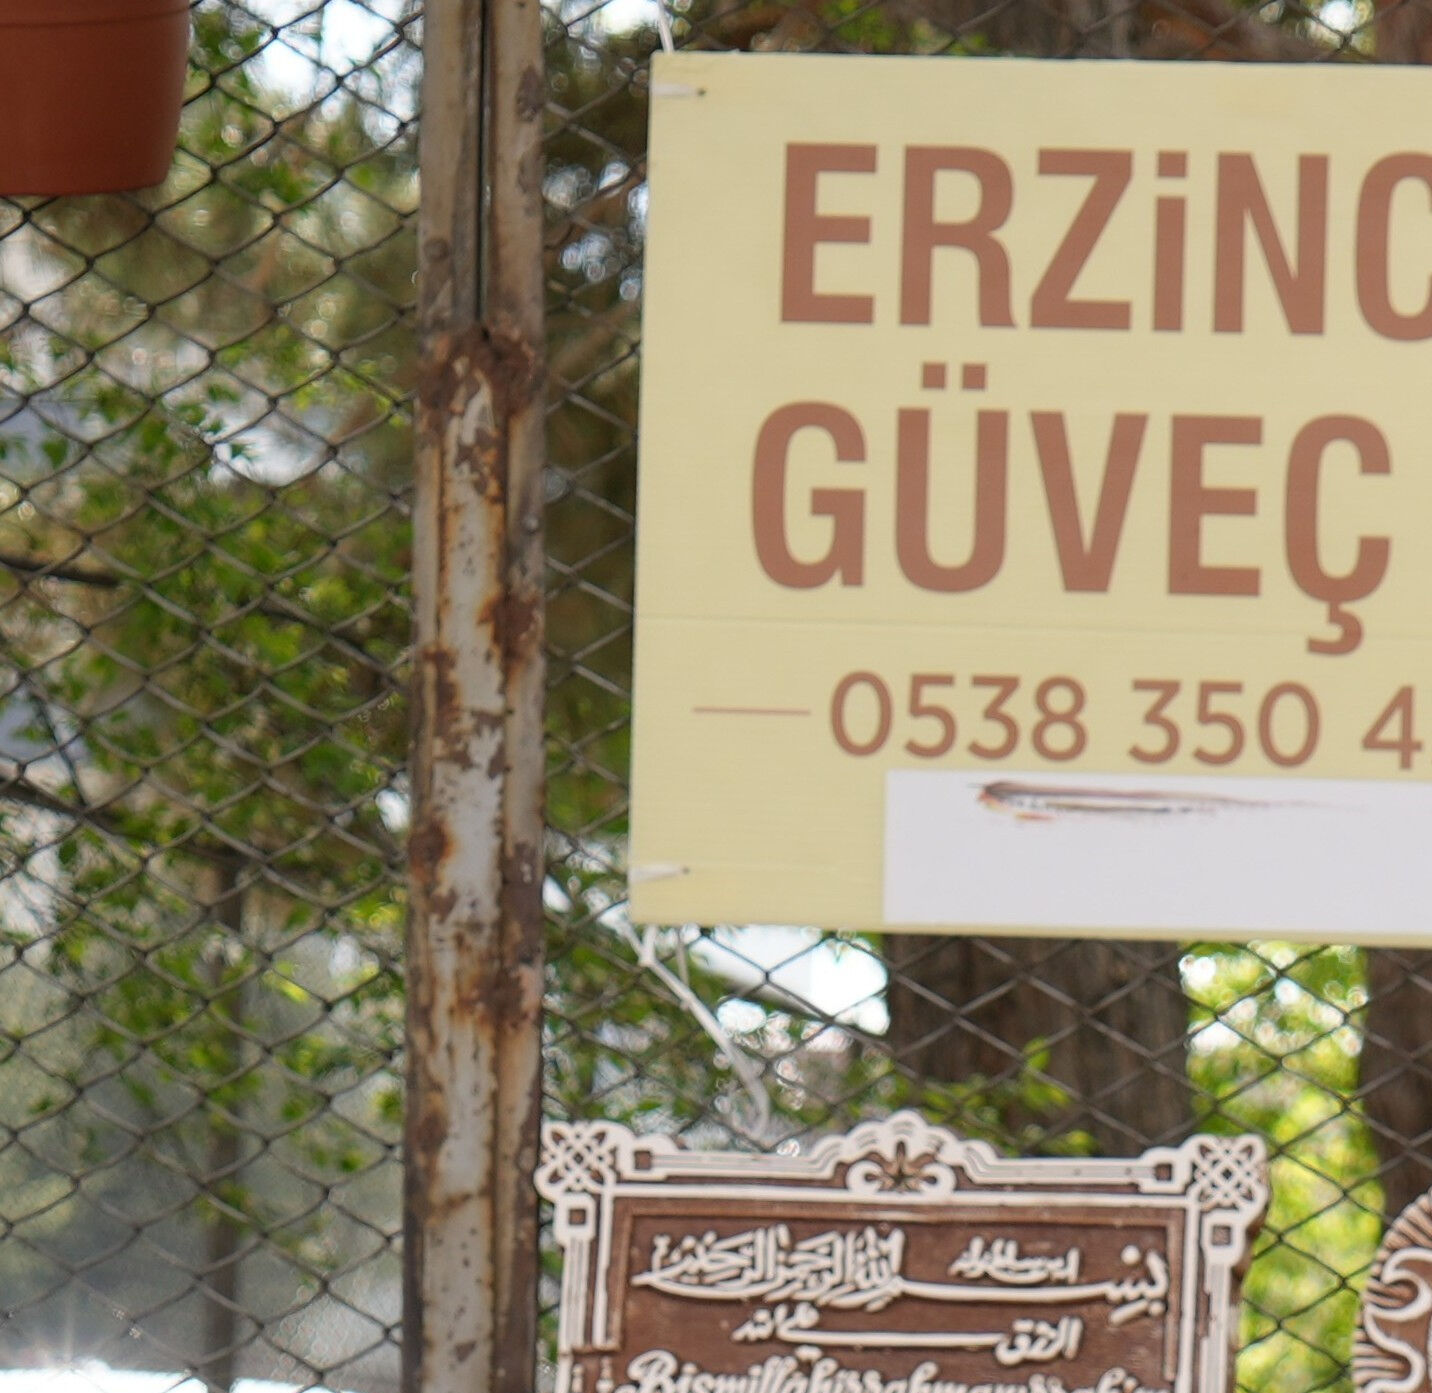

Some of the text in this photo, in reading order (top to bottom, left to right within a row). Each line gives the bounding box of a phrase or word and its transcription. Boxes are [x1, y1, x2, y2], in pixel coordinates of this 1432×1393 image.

[750, 362, 1392, 655] GÜVEÇ
[829, 671, 1089, 762] 0538
[1129, 679, 1321, 767] 350
